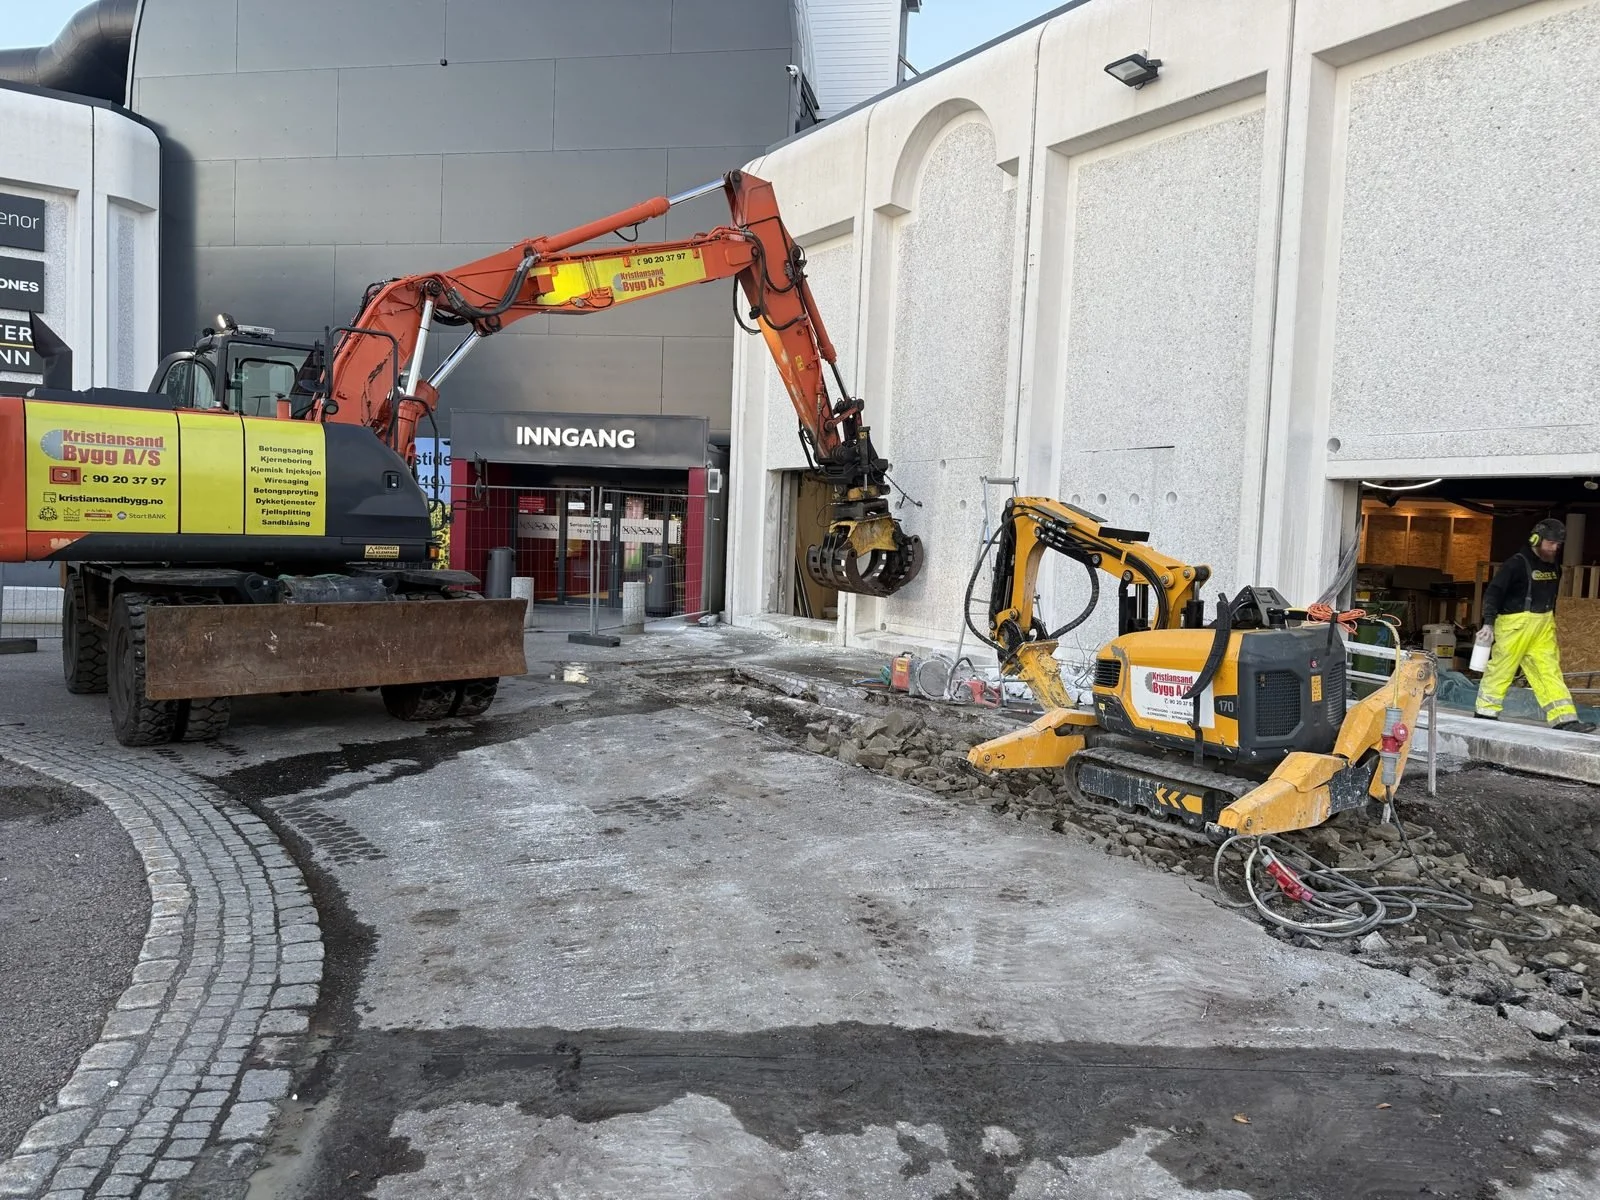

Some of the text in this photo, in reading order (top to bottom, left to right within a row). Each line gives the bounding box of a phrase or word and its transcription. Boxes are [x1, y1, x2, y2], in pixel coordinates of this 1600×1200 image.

[643, 257, 653, 265] 90
[654, 255, 665, 263] 20
[676, 252, 686, 260] 97
[620, 268, 664, 280] Kristiansand
[622, 276, 665, 292] Bygg A/S
[0, 324, 33, 343] ER
[63, 429, 164, 448] Kristiansand
[516, 426, 636, 449] INNGANG
[63, 445, 161, 466] Bygg A/S
[258, 445, 314, 455] Betongsaging
[260, 456, 312, 465] Kjerneboring
[250, 466, 322, 476] Kjemisk Injeksjon
[92, 474, 167, 486] 90 20 37 97
[264, 477, 309, 486] Wiresaging
[253, 487, 319, 497] Betongsprøyting
[58, 494, 164, 506] kristiansandbygg.no
[255, 498, 316, 506] Dykketjenester
[261, 508, 311, 517] Fjellsplitting
[261, 519, 311, 528] Sandblåsing
[1152, 671, 1193, 684] Kristiansand
[1152, 682, 1175, 697] Bygg
[1218, 700, 1234, 713] 170
